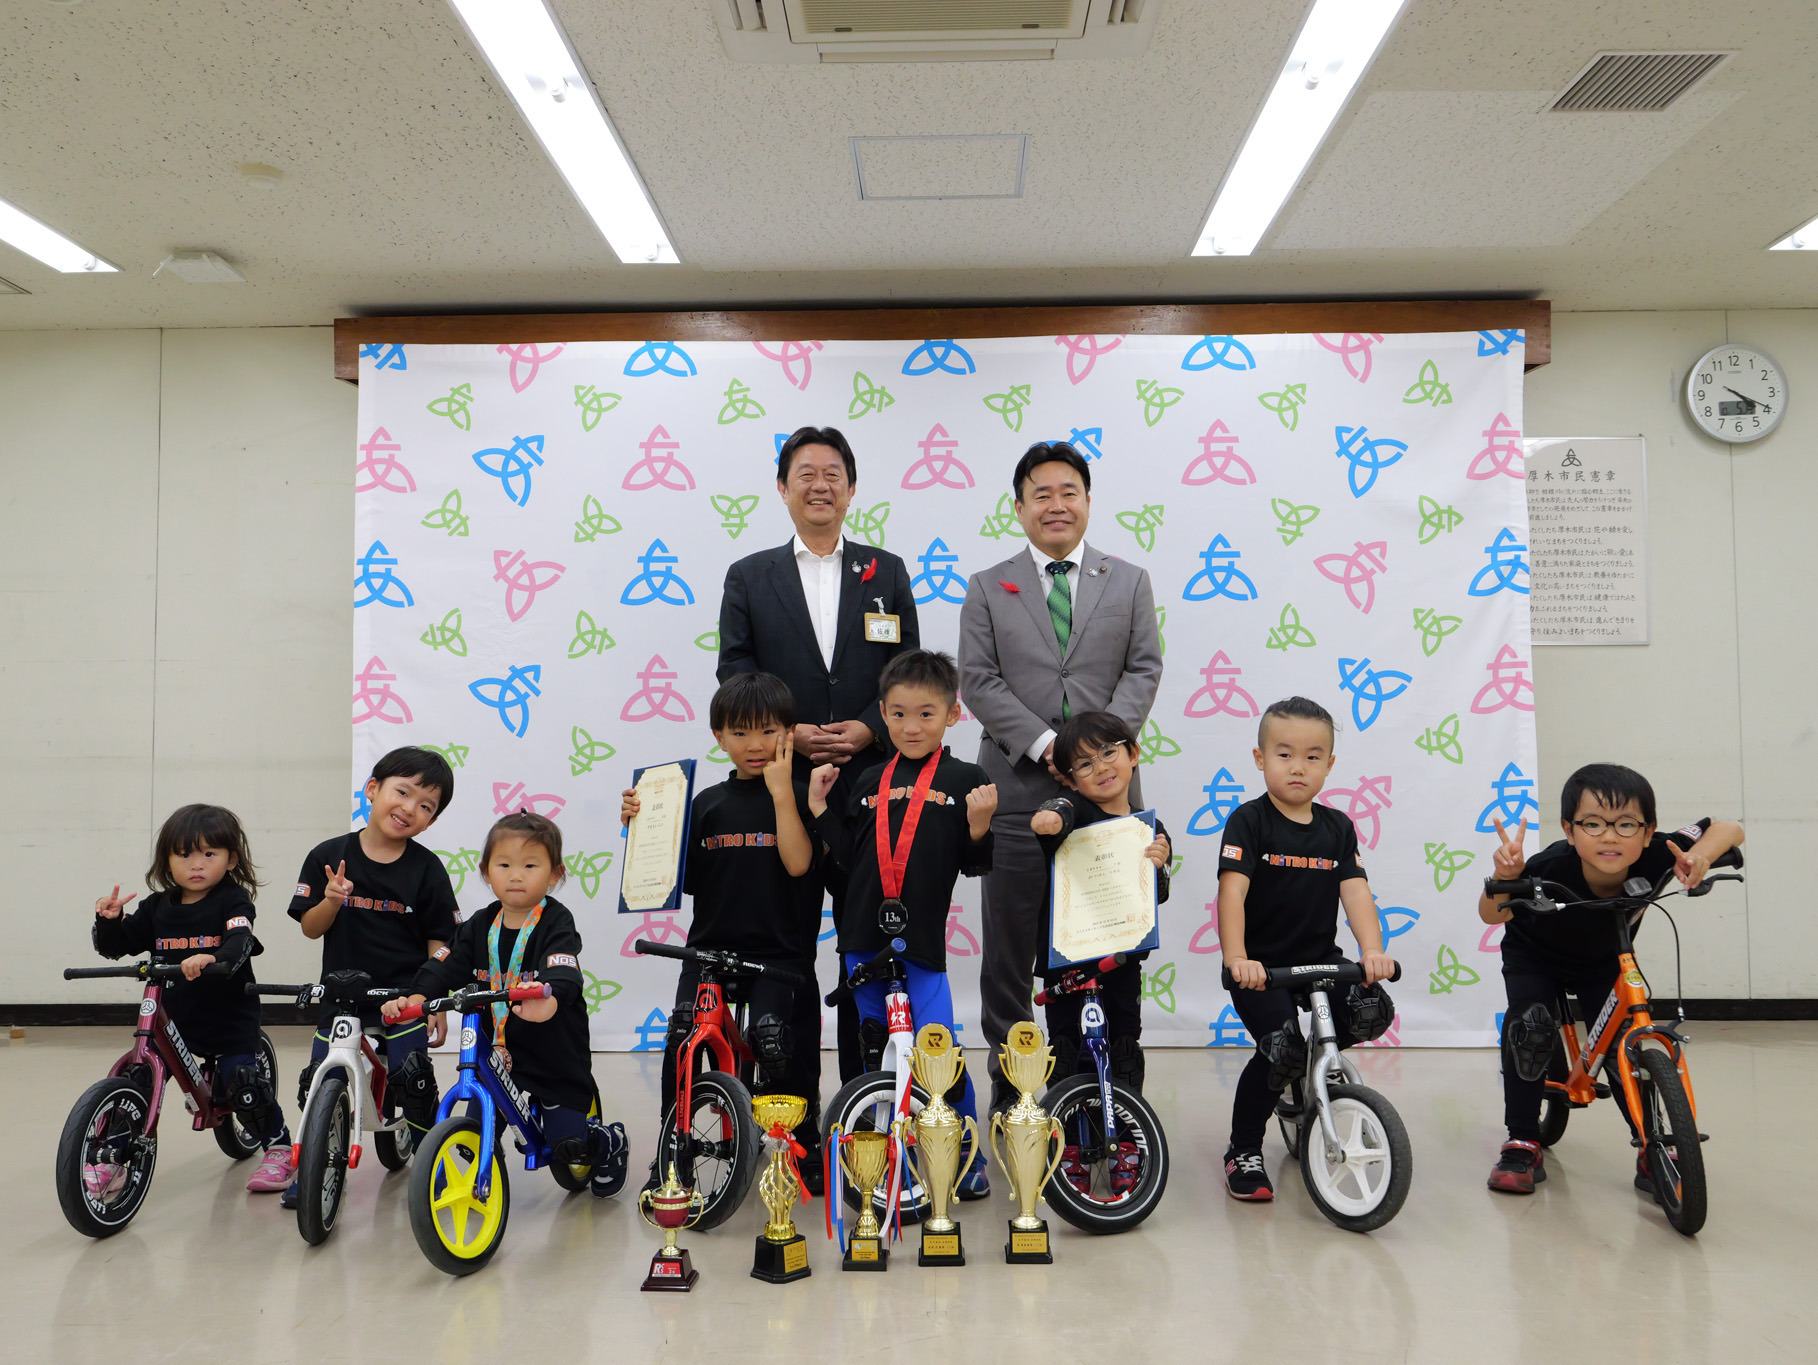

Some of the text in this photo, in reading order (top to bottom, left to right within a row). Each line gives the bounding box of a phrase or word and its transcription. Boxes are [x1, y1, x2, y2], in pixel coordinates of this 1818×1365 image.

[1712, 360, 1723, 372] 11
[1728, 355, 1740, 367] 12
[1749, 358, 1754, 370] 1
[1701, 373, 1713, 385] 10
[1761, 369, 1769, 381] 2
[1697, 389, 1706, 401] 9
[1768, 386, 1776, 398] 3
[1704, 405, 1713, 418] 8
[1718, 418, 1726, 430] 7
[1735, 421, 1744, 433] 6
[1752, 416, 1761, 428] 5
[1528, 470, 1616, 482] 厚木市民憲章
[1270, 854, 1308, 869] NITRO
[885, 911, 901, 922] 13th
[189, 935, 222, 949] KIDS
[548, 955, 577, 967] NOS
[1291, 964, 1340, 974] STRIDER
[1588, 988, 1619, 1050] STRIDER
[165, 1020, 203, 1088] STRIDER
[489, 1050, 532, 1122] STRIDER
